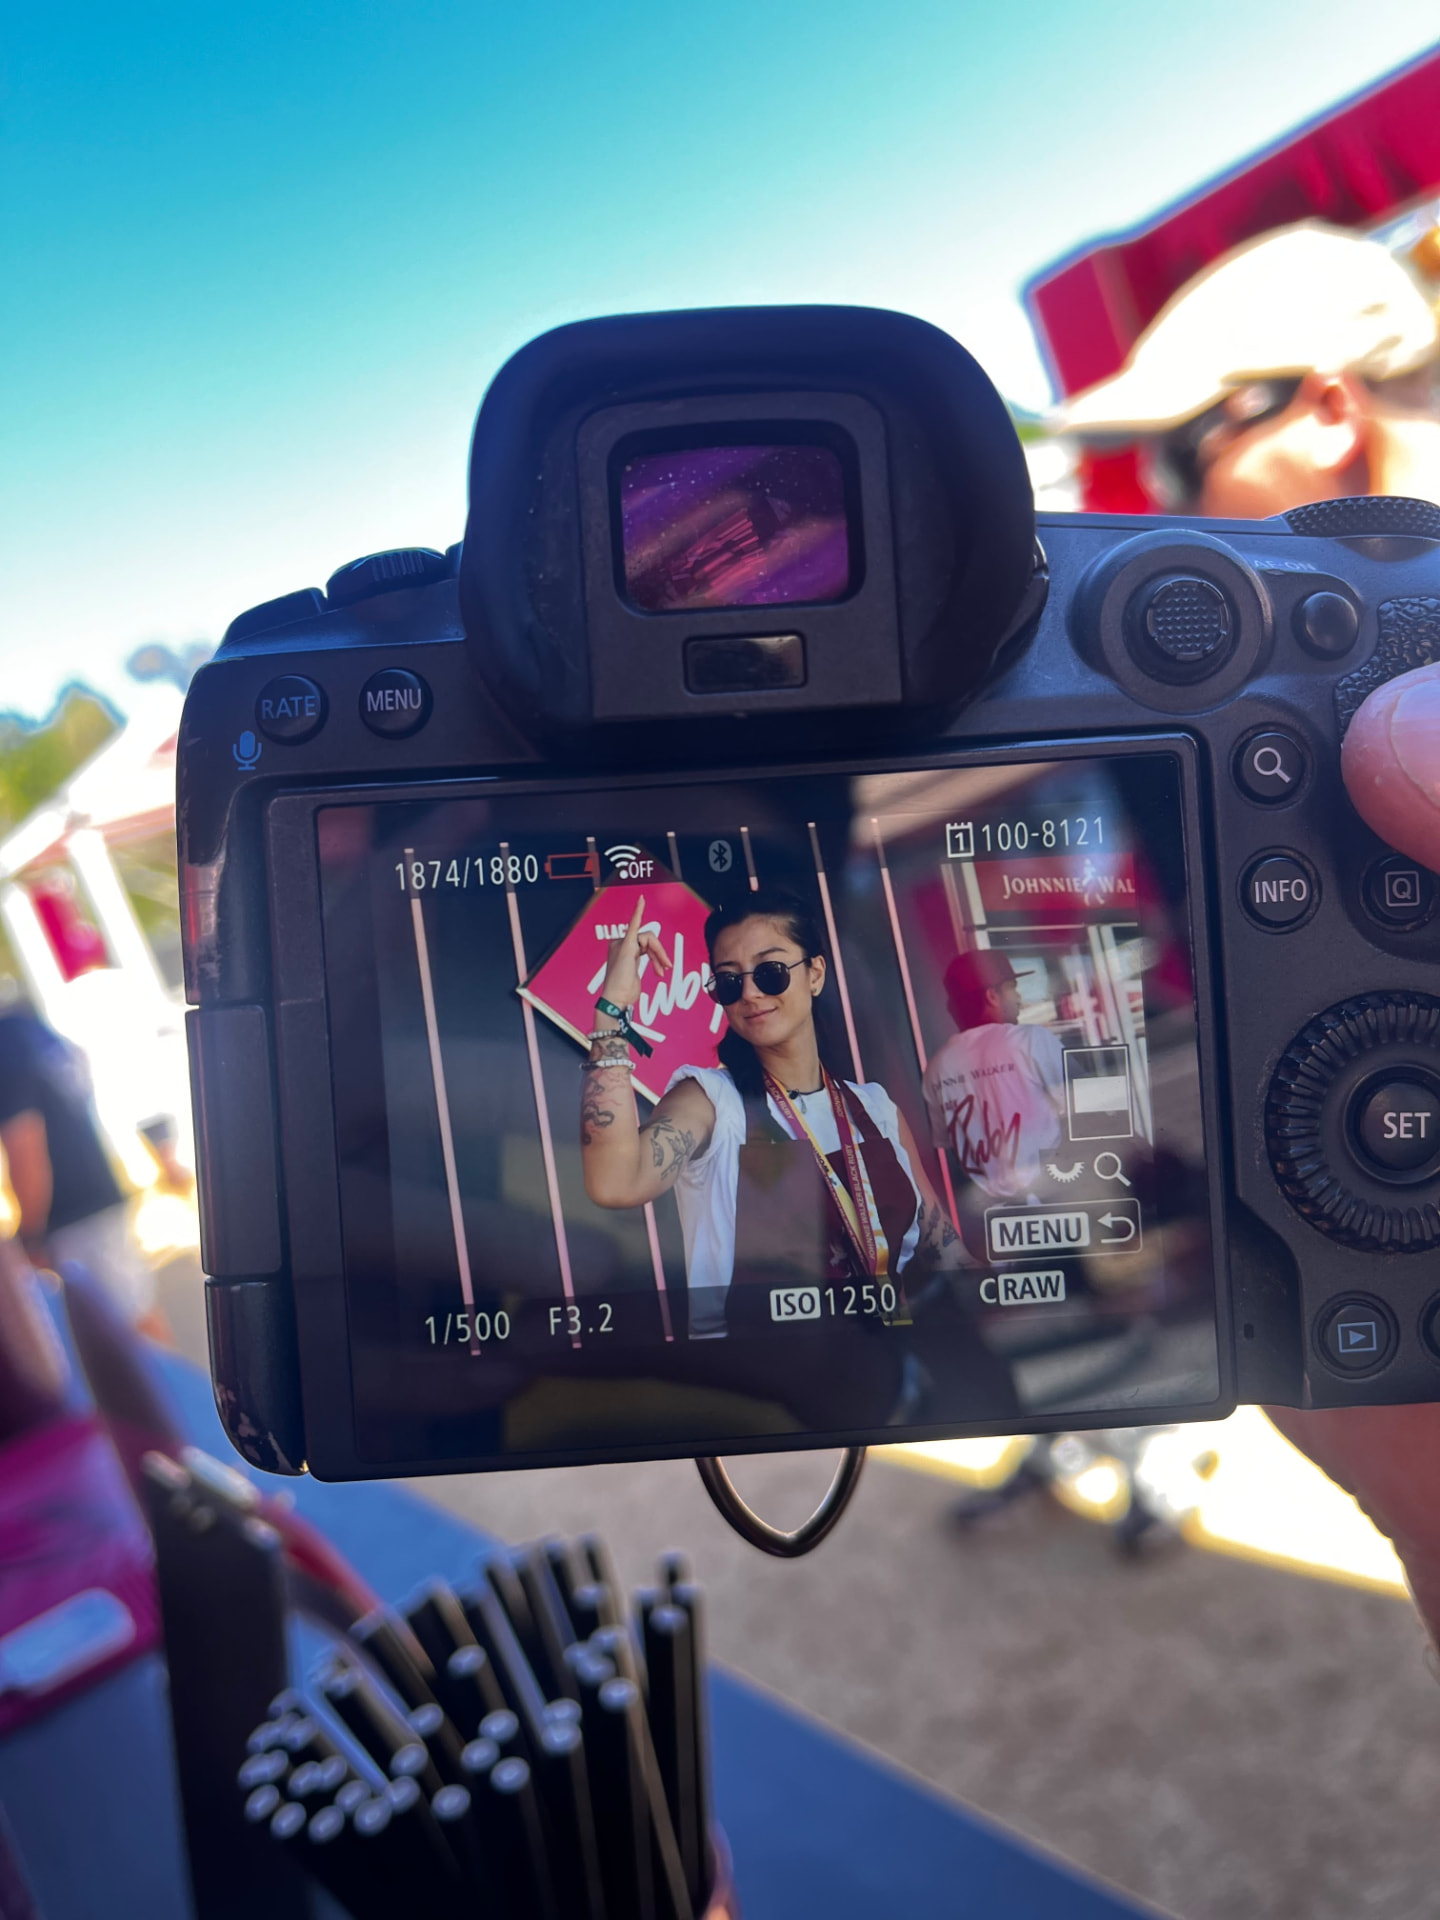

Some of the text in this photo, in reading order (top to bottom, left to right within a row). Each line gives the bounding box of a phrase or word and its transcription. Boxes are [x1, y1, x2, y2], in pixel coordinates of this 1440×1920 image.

[261, 695, 316, 719] RATE
[366, 688, 422, 712] MENU
[982, 816, 1103, 851] 100-8121
[395, 854, 538, 890] 1874/1880
[628, 860, 654, 879] OFF
[1003, 874, 1081, 899] JOHNNIE
[1255, 878, 1307, 903] INFO
[1392, 878, 1412, 899] Q
[595, 923, 630, 940] BLAC
[1383, 1112, 1431, 1139] SET
[1000, 1217, 1082, 1247] MENU
[776, 1283, 896, 1316] ISO 1250
[425, 1303, 614, 1345] 1/500 F3.2
